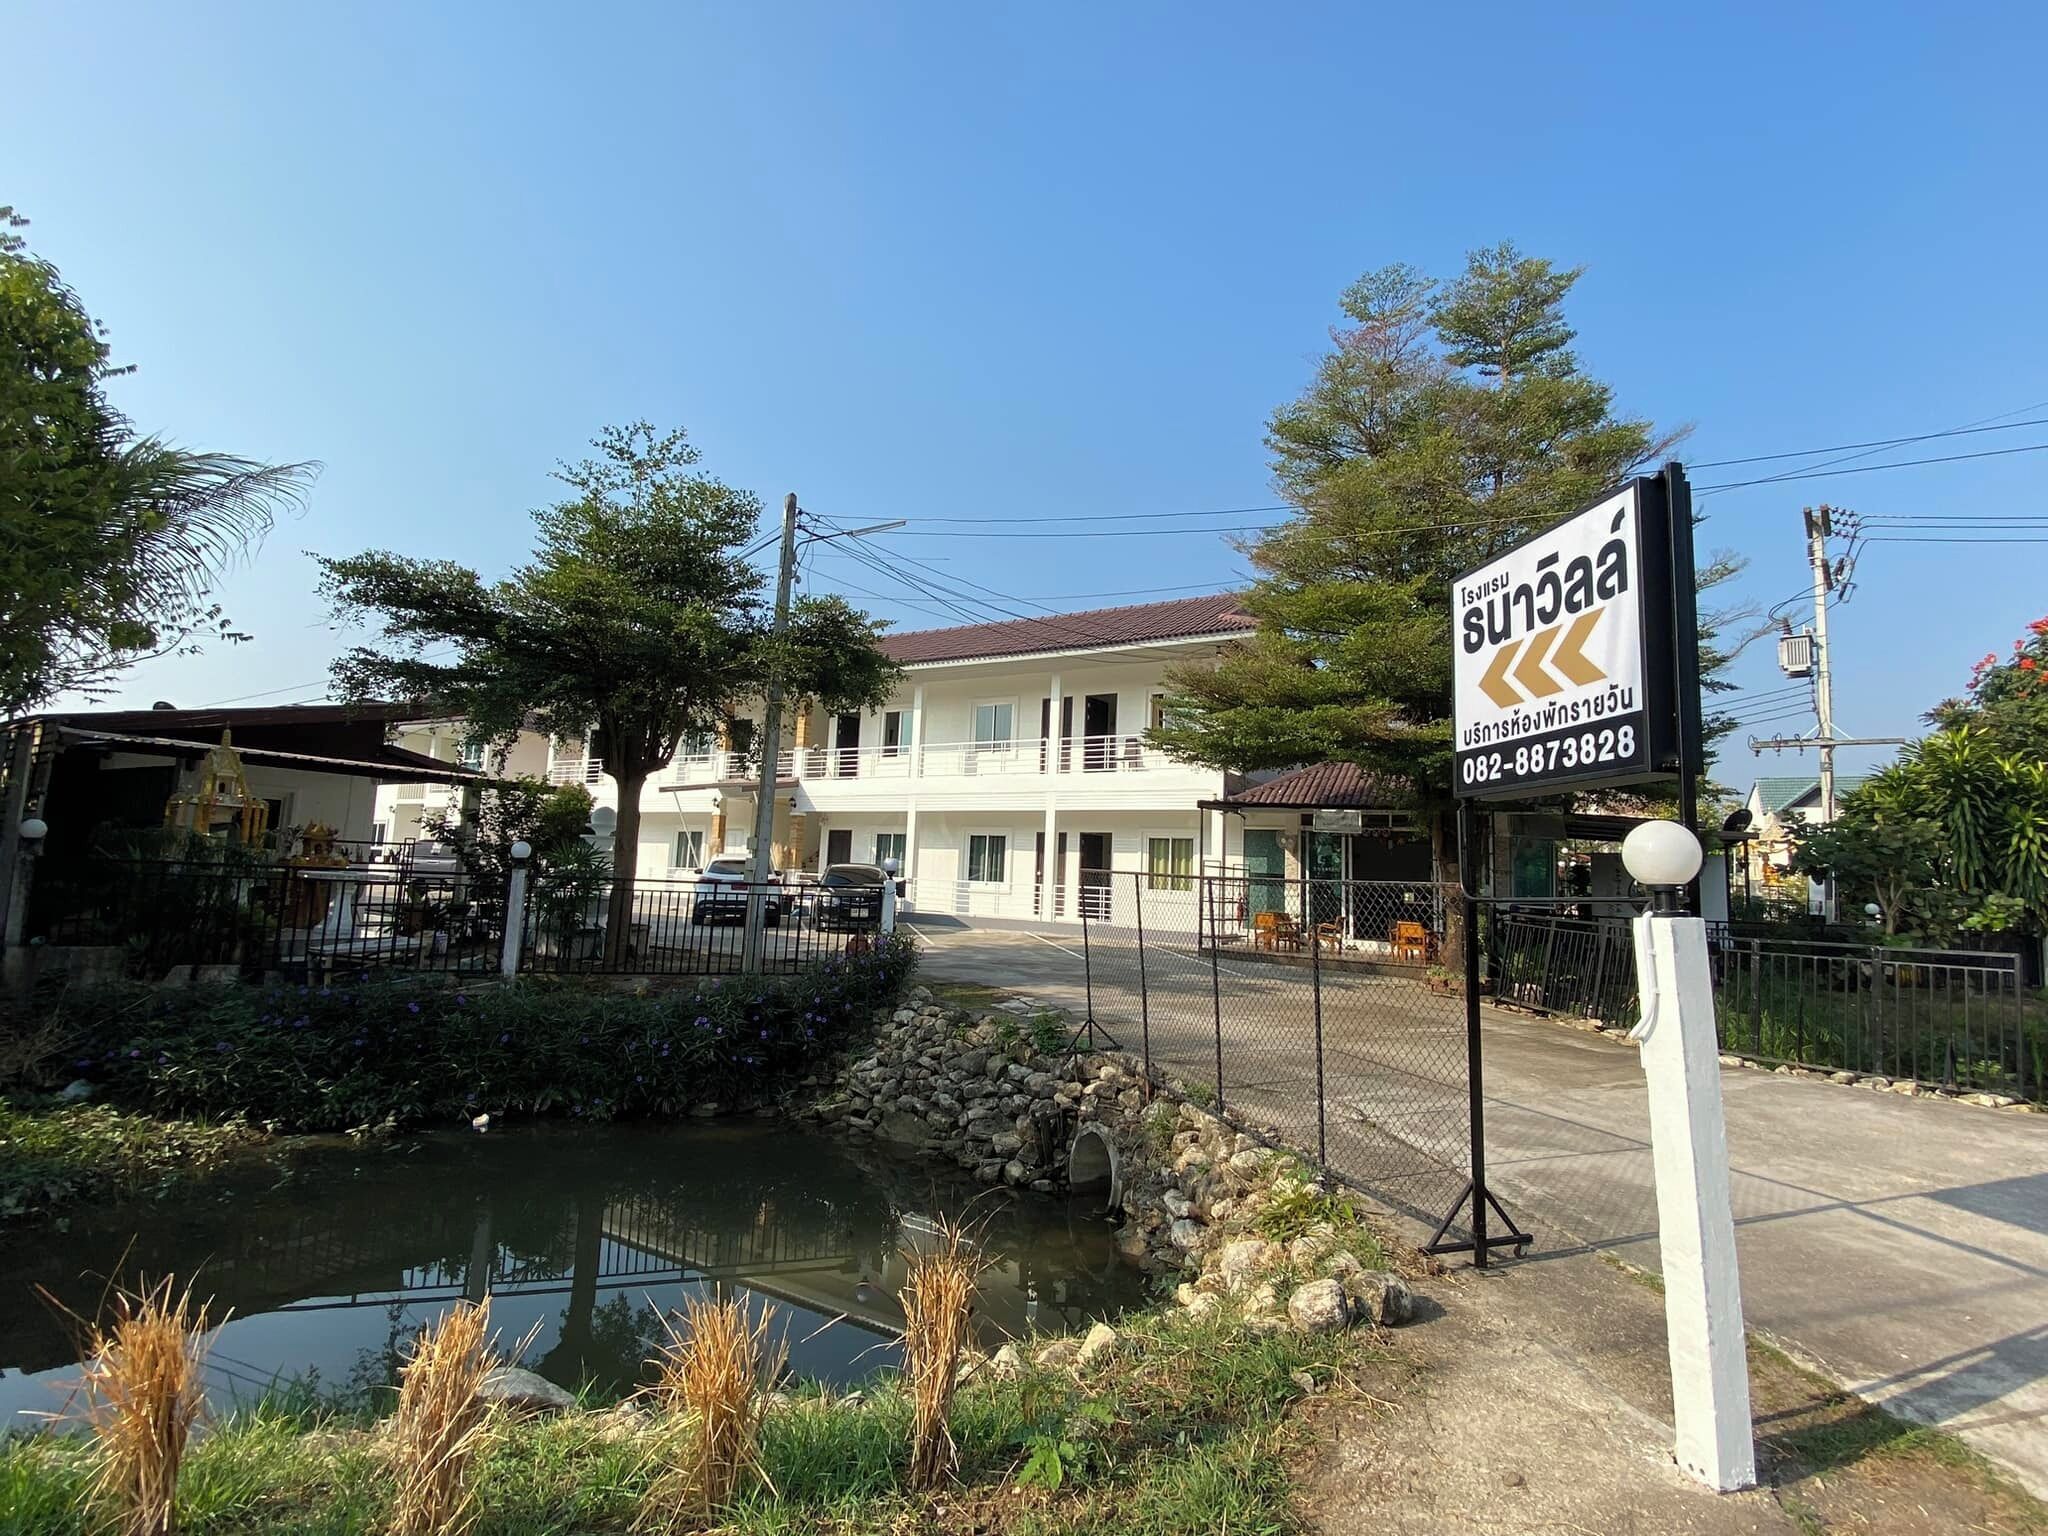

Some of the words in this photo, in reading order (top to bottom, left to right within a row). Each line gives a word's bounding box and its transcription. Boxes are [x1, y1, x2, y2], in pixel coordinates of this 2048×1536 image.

[1461, 571, 1510, 608] โรงแรม
[1462, 506, 1628, 655] ธนาวิลล์
[1463, 683, 1634, 747] บริการห้องพักรายวัน
[1462, 724, 1635, 785] 082-8873828
